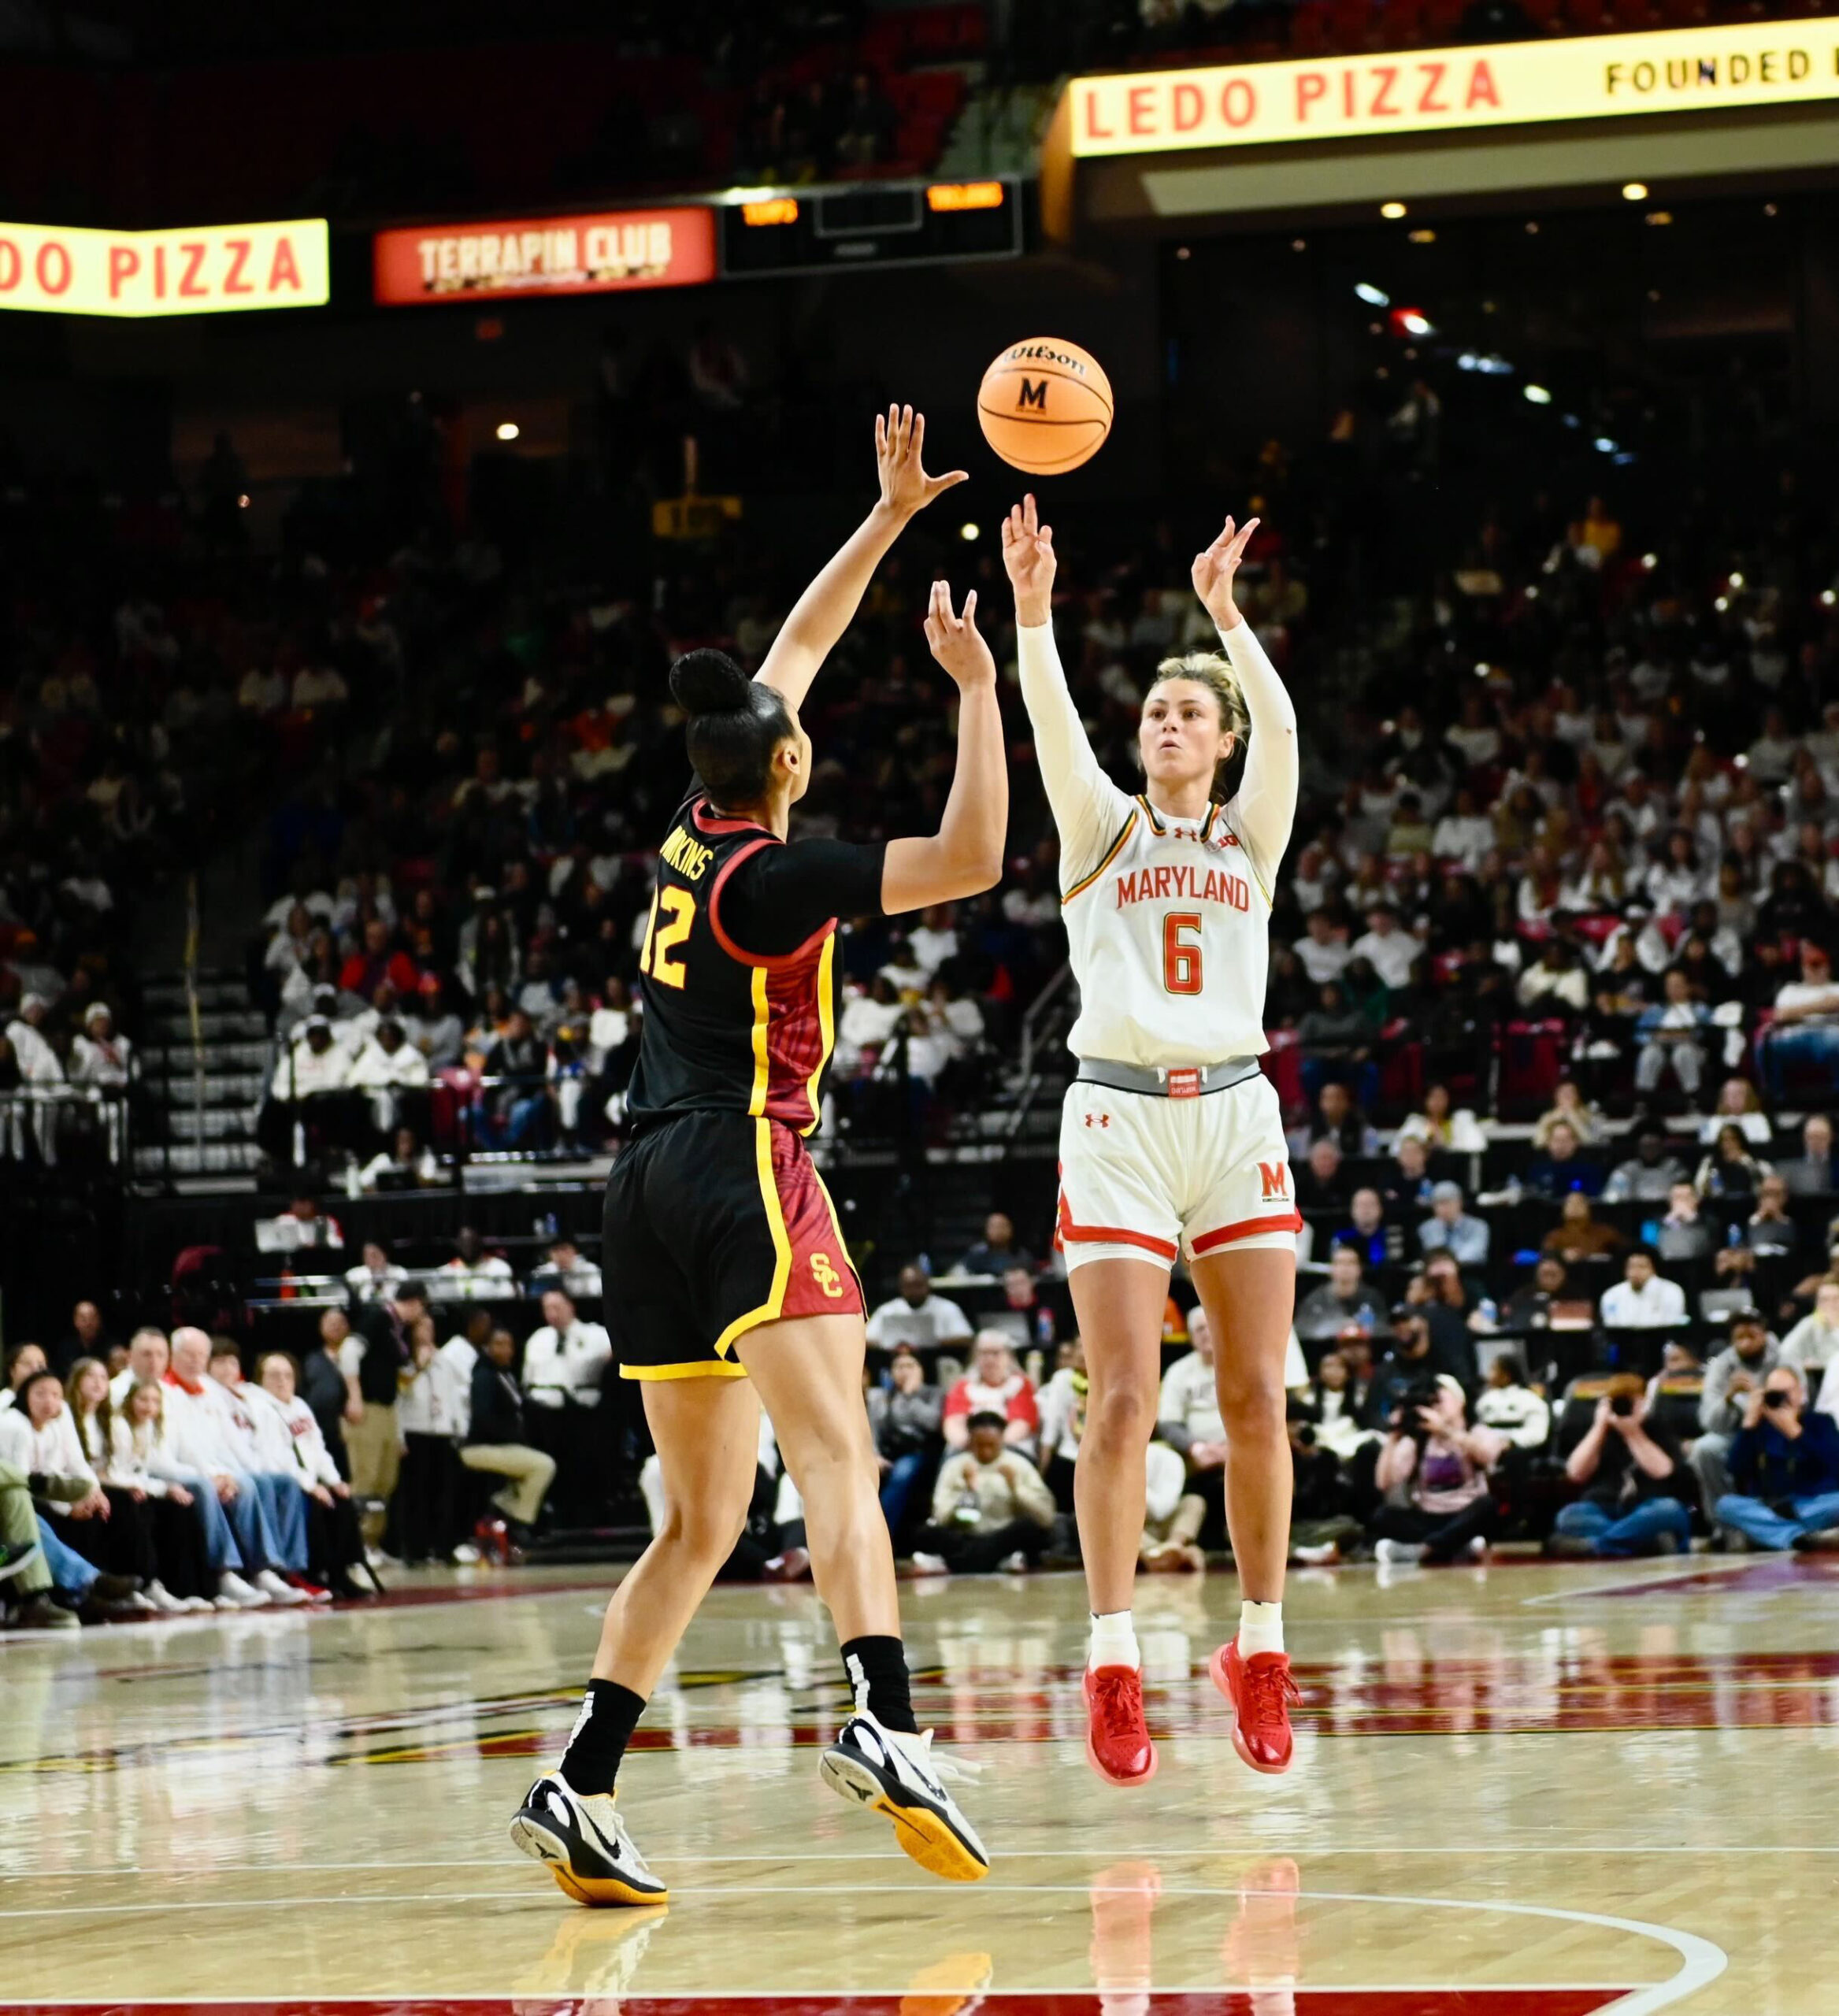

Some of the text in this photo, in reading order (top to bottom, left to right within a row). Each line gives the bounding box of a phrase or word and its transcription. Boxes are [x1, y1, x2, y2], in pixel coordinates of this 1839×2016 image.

[1607, 49, 1810, 94] FOUNDED
[1086, 60, 1501, 139] LEDO PIZZA
[109, 237, 302, 299] PIZZA
[419, 221, 671, 281] TERRAPIN CLUB
[1004, 345, 1084, 376] Wilson
[1019, 378, 1048, 409] M
[1116, 865, 1250, 913] MARYLAND
[640, 882, 696, 990] 12
[1163, 911, 1203, 995] 6
[1256, 1161, 1288, 1197] M
[810, 1252, 843, 1298] SC
